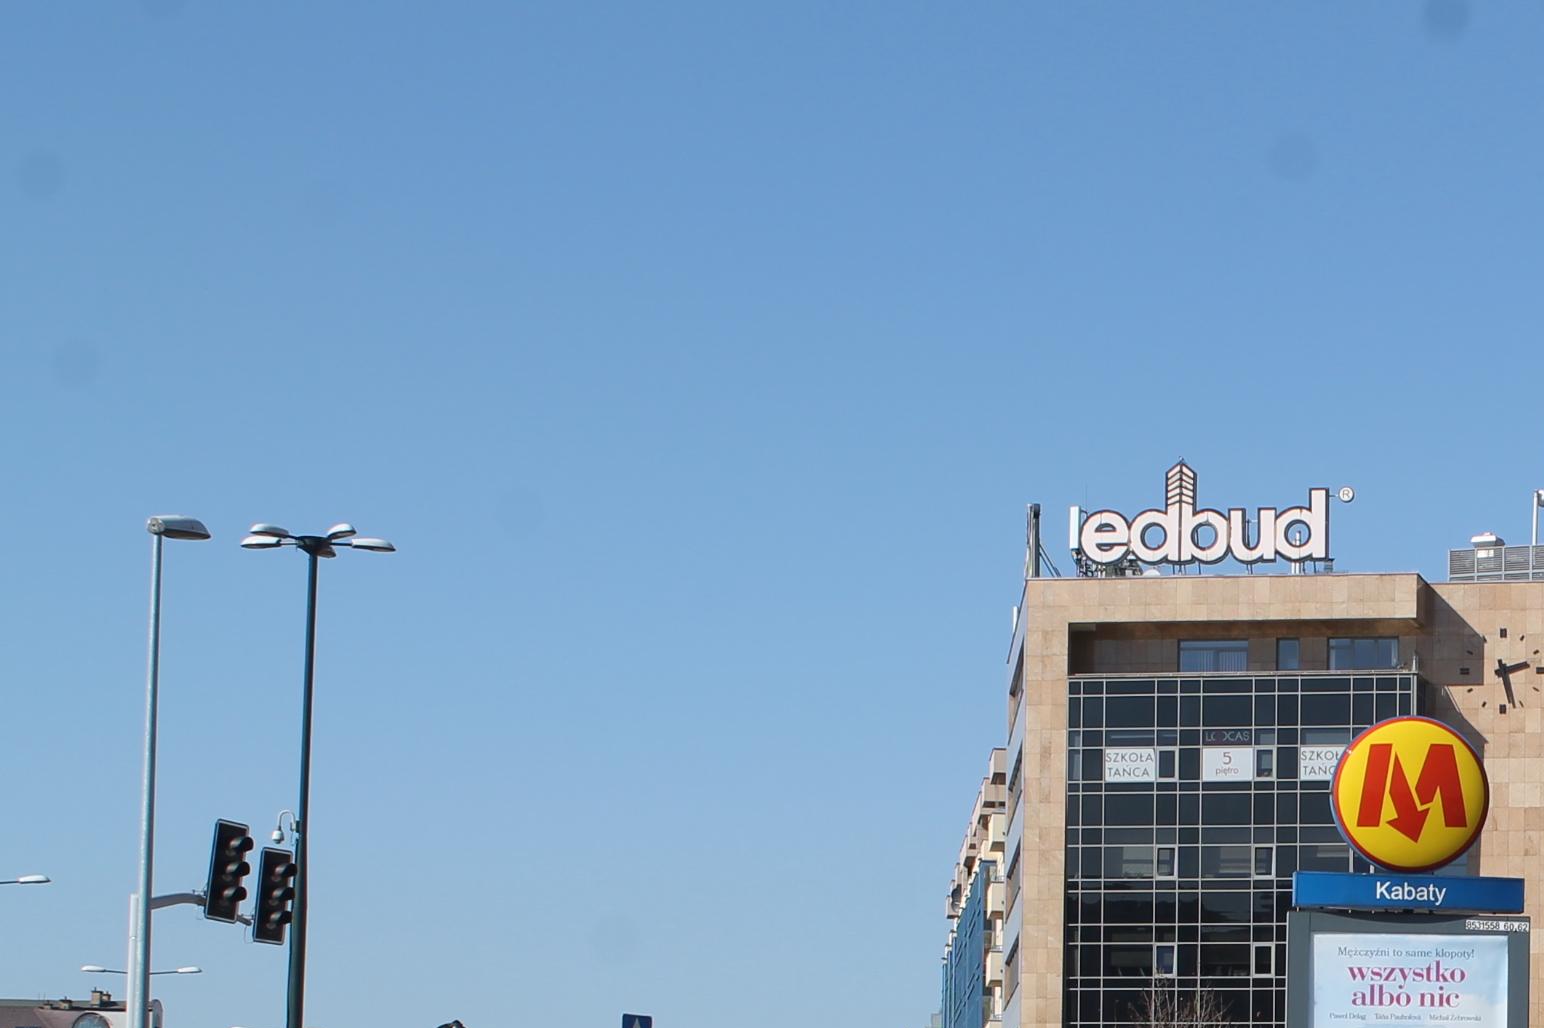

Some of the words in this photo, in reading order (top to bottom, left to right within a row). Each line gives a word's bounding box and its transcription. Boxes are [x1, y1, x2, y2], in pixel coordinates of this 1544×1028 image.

[1081, 460, 1329, 565] edbud
[1105, 751, 1154, 763] SZKOŁA
[1222, 751, 1232, 765] 5
[1301, 750, 1339, 761] SZKOŁ
[1107, 764, 1150, 777] TAŃCA
[1215, 766, 1240, 777] piętro
[1302, 762, 1336, 776] TAŃC
[1376, 880, 1447, 905] Kabaty
[1466, 920, 1500, 930] 8531558
[1337, 946, 1390, 959] Mężczyźni
[1392, 948, 1403, 957] to
[1405, 950, 1433, 958] same
[1435, 948, 1475, 960] kłopoty!
[1347, 960, 1466, 990] wszystko
[1351, 983, 1412, 1008] albo
[1419, 985, 1461, 1008] nic
